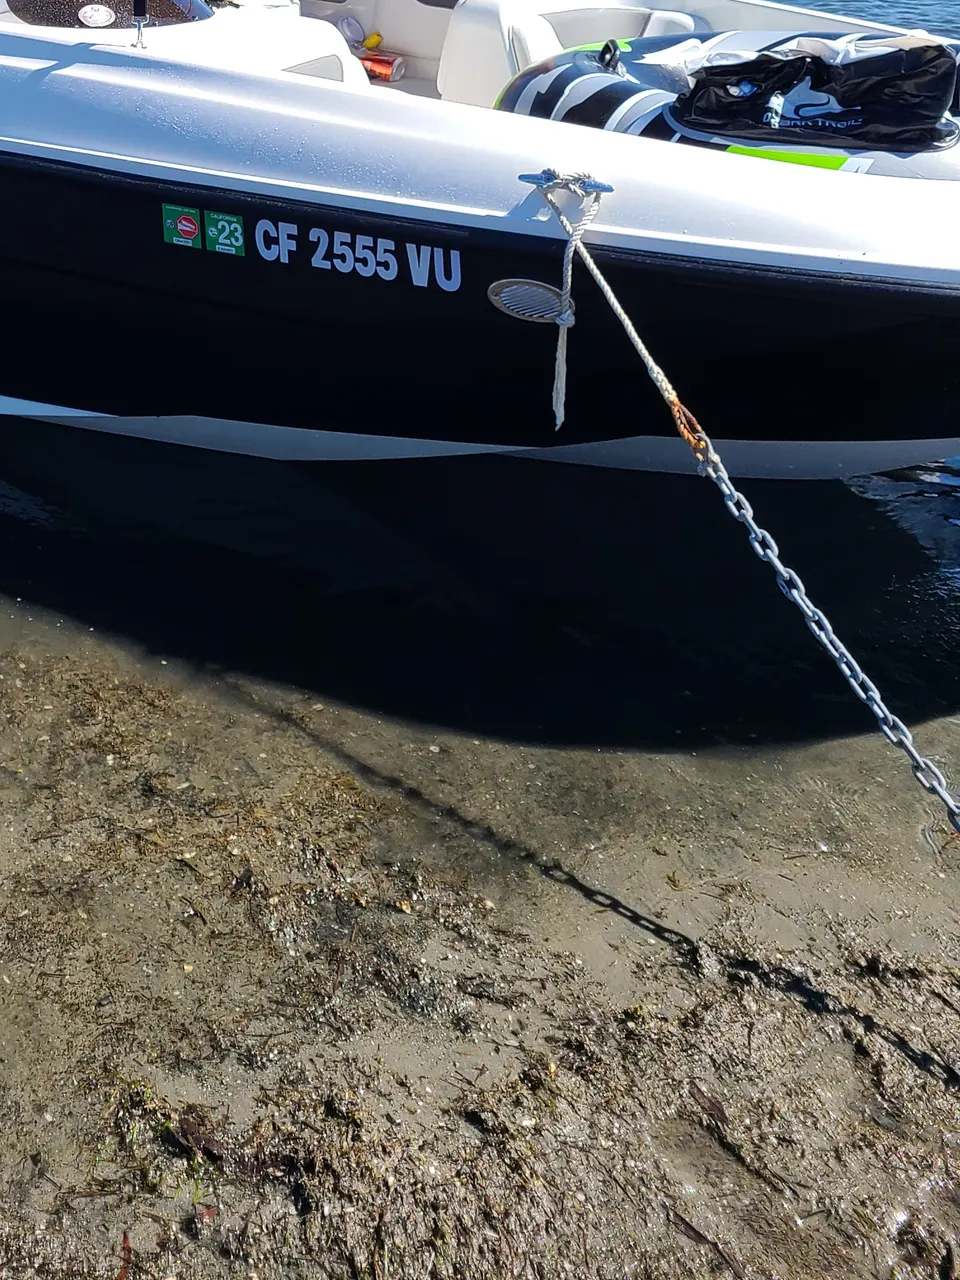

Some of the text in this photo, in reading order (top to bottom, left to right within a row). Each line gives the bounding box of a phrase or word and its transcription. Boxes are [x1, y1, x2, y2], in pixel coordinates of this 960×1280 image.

[210, 213, 237, 222] CALIFORNIA
[217, 220, 243, 247] 23
[255, 219, 462, 292] CF 2555 VU
